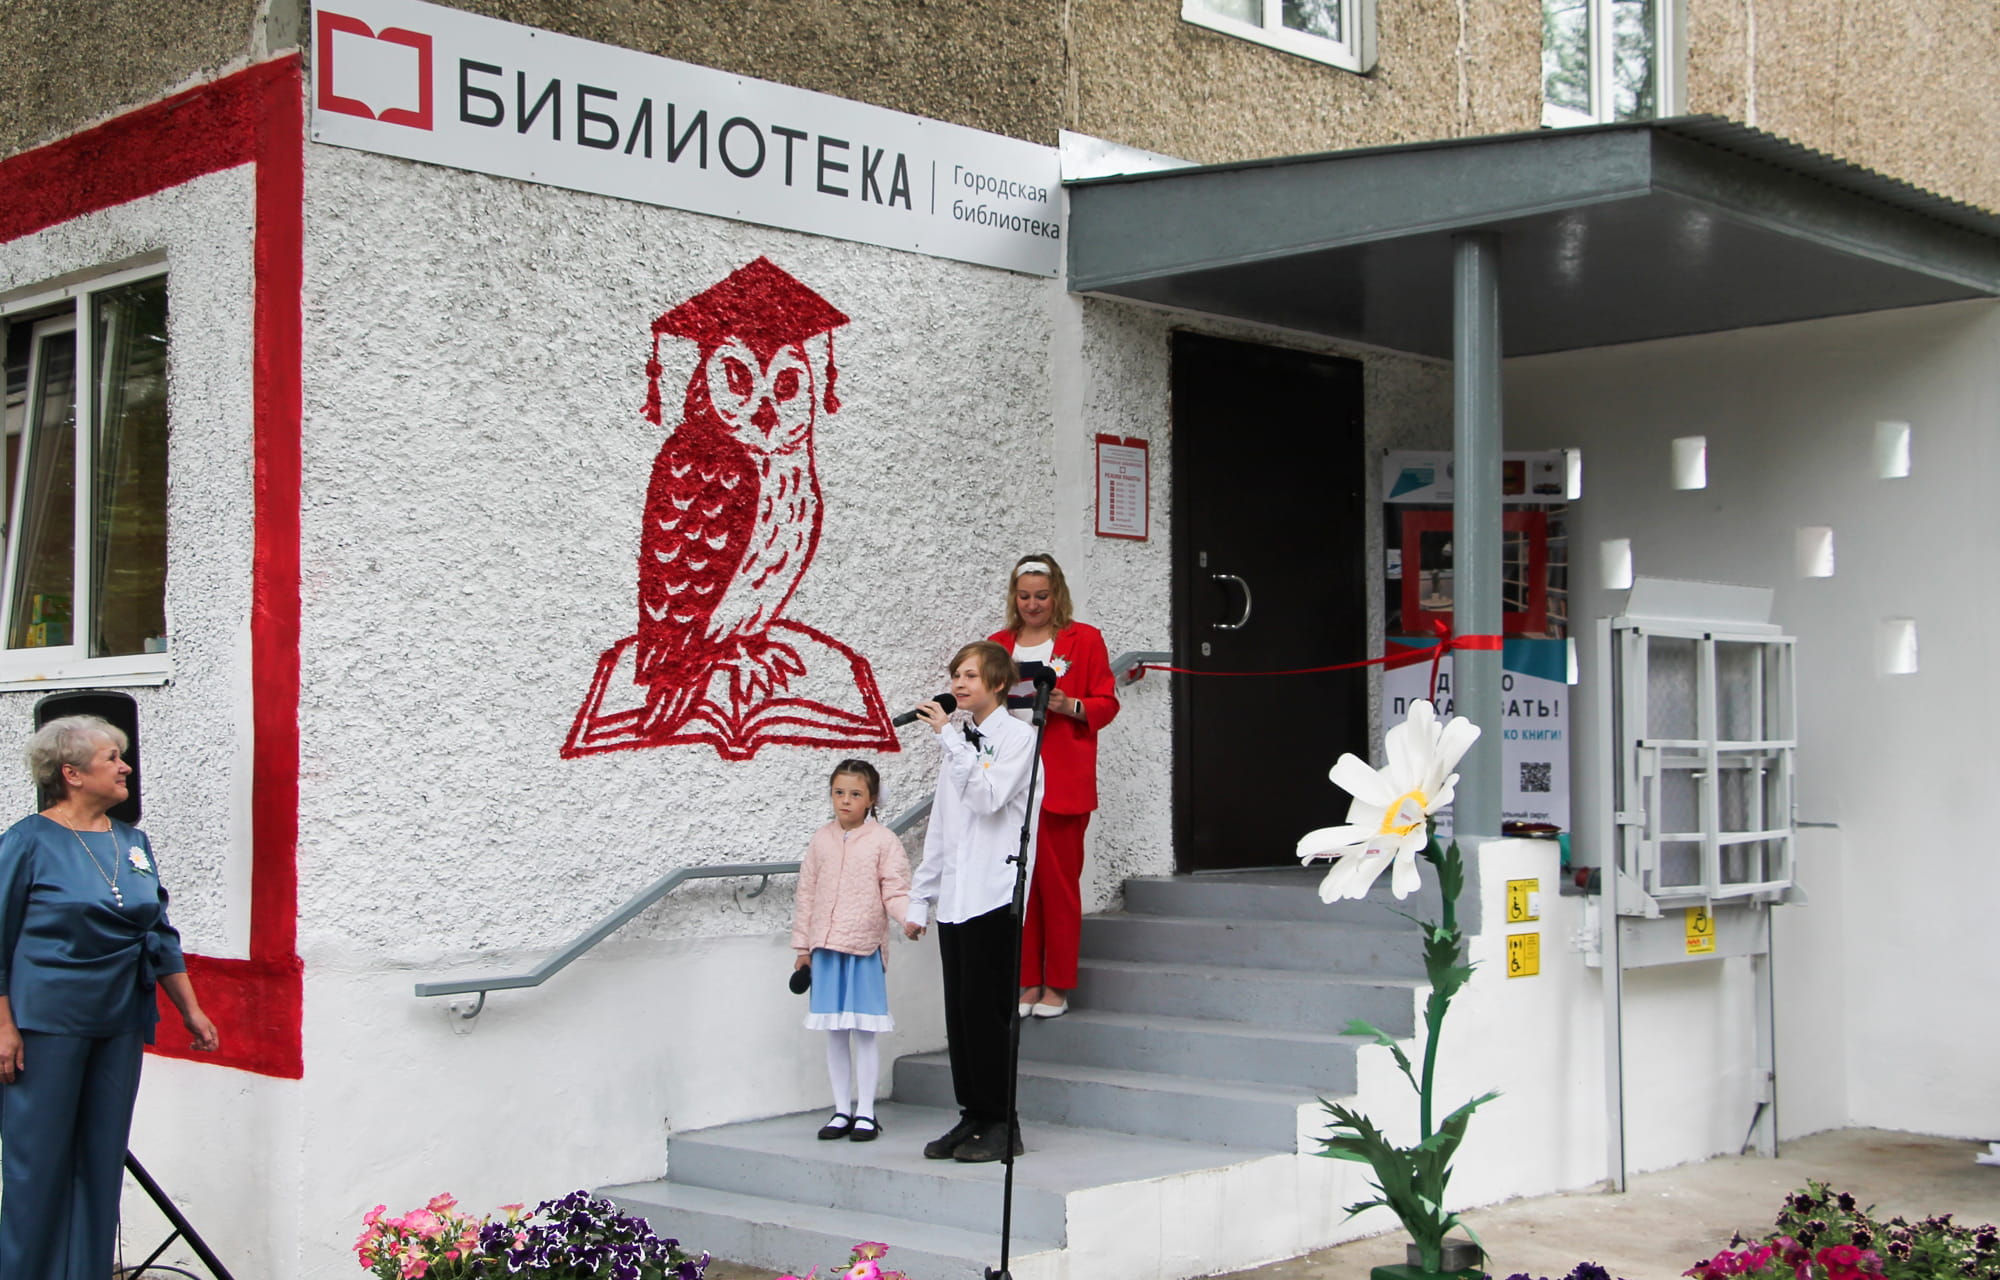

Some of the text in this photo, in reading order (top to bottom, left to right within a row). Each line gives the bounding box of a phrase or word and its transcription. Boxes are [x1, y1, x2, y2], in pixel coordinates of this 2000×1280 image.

[459, 58, 912, 210] БИБЛИОТЕКА
[954, 164, 1047, 204] Городская
[952, 199, 1060, 239] библиотека
[1521, 729, 1562, 741] КНИГИ!
